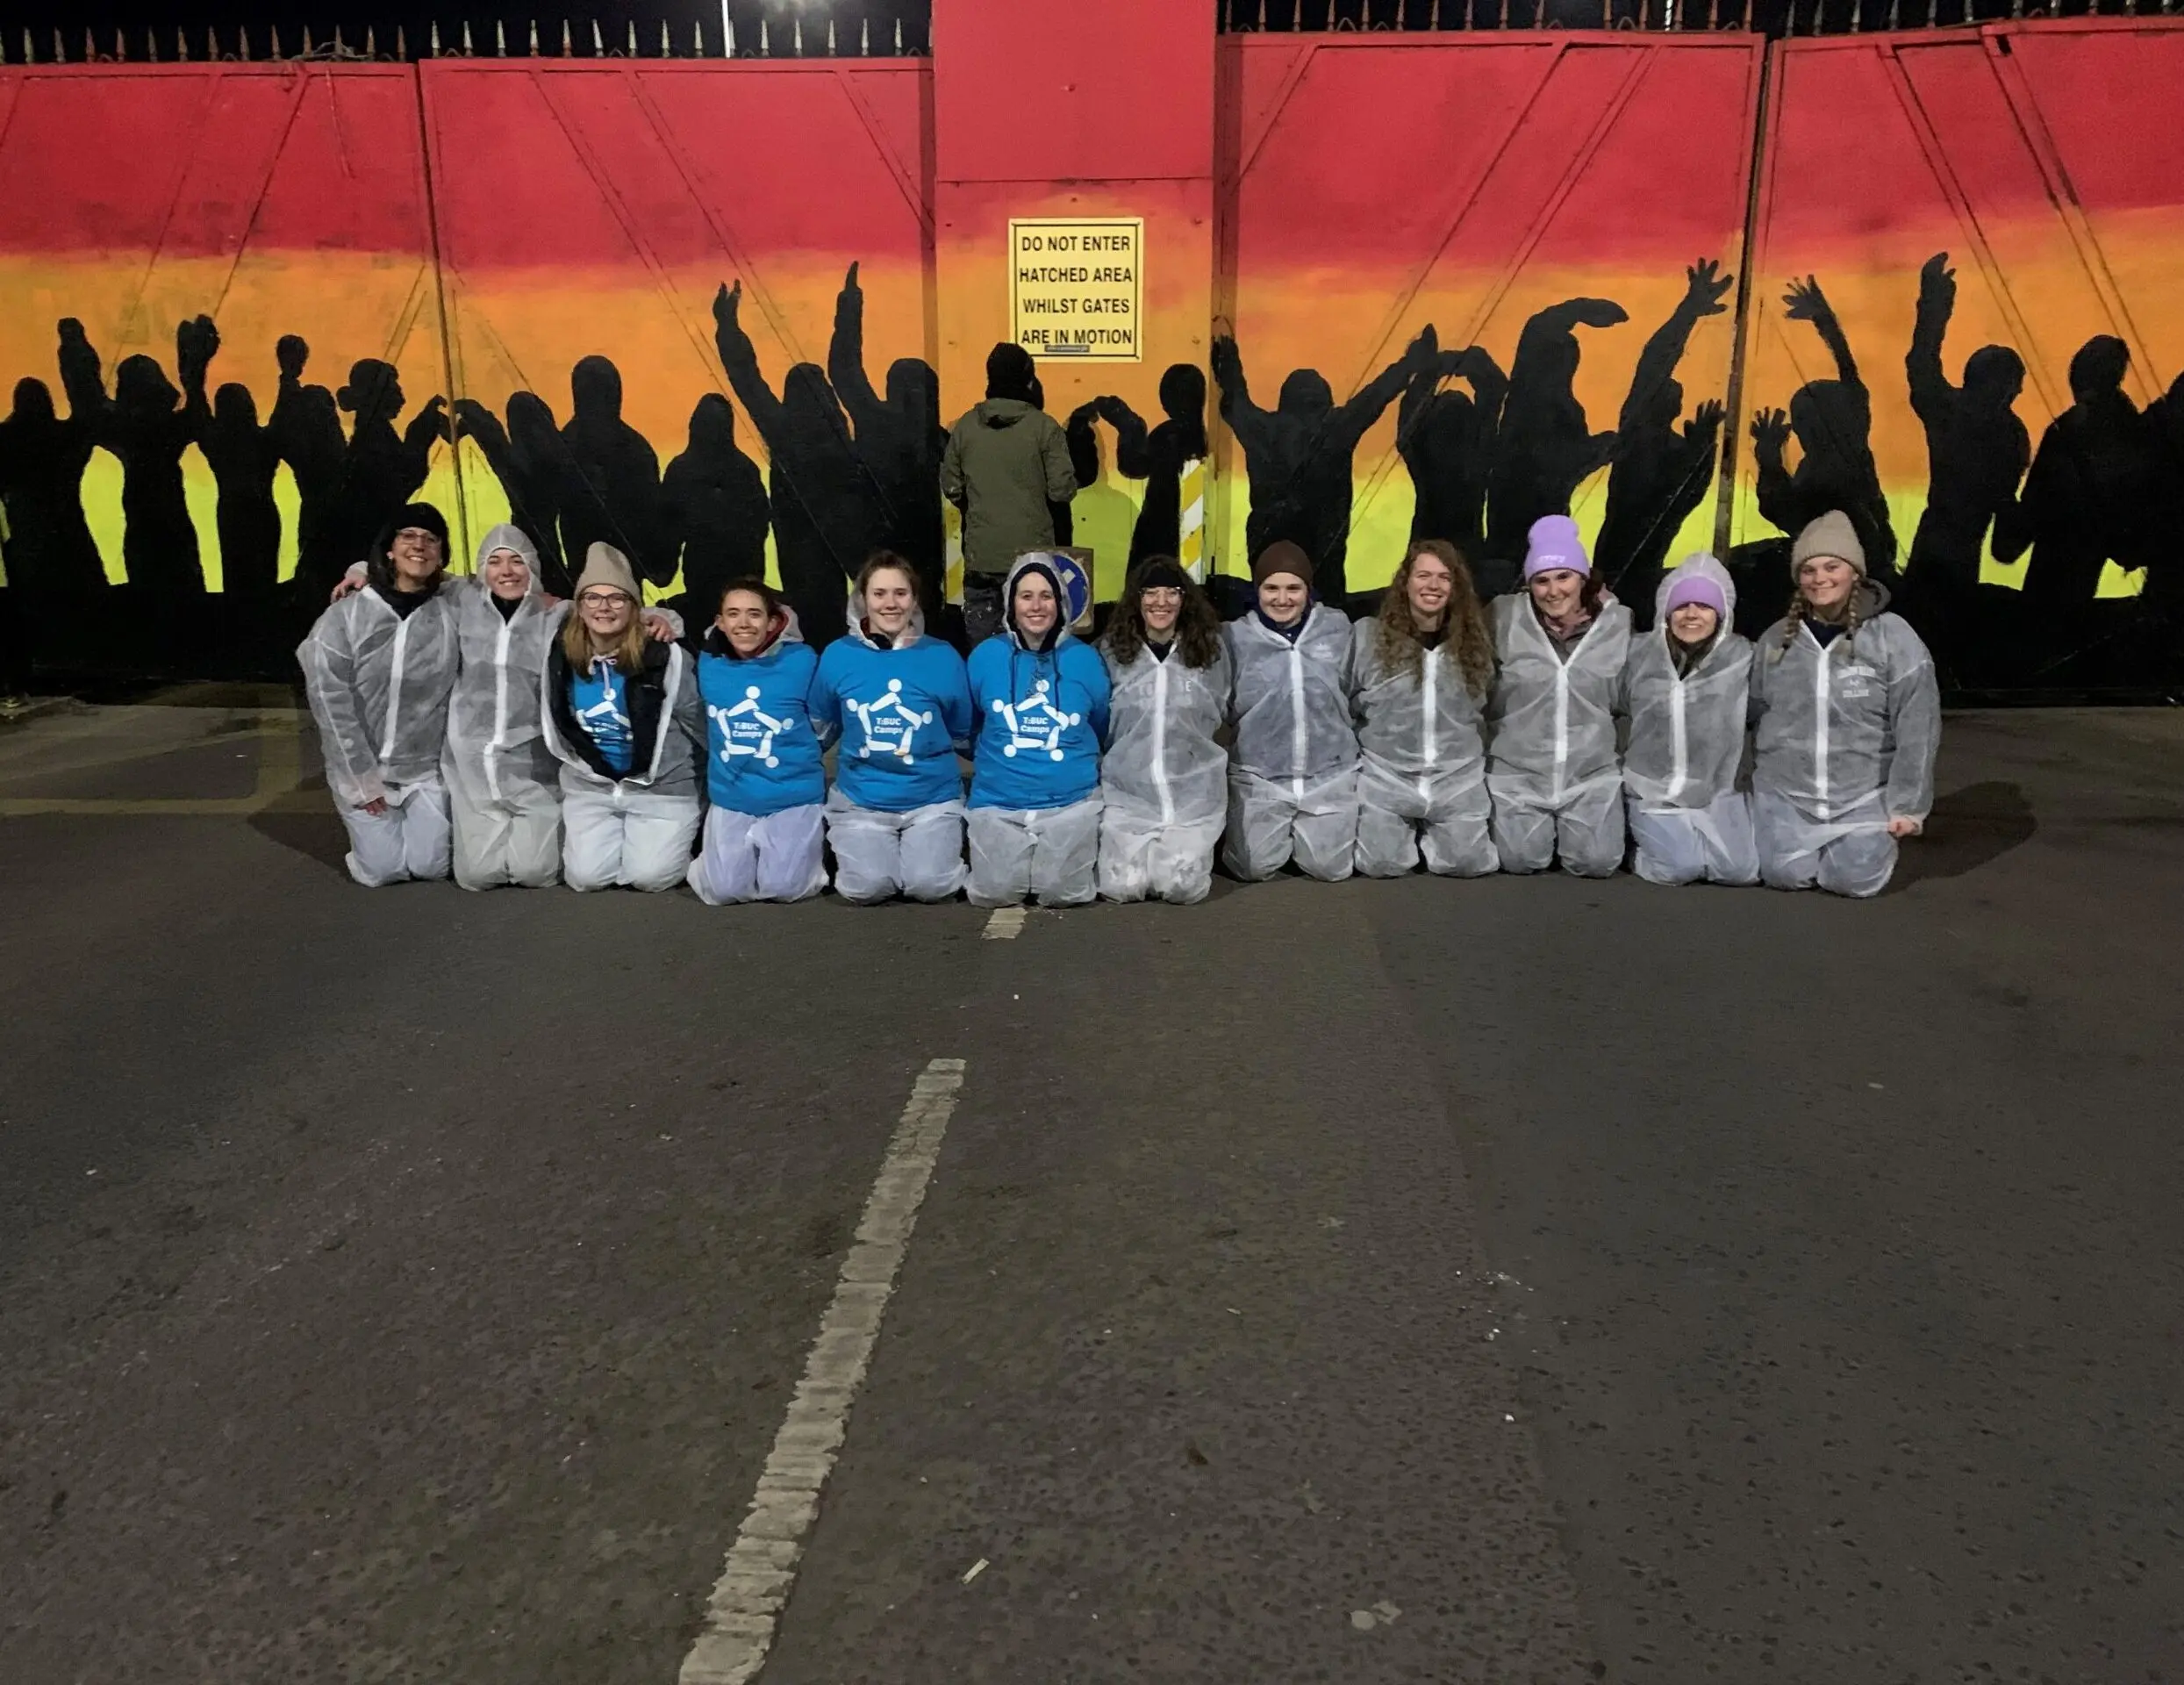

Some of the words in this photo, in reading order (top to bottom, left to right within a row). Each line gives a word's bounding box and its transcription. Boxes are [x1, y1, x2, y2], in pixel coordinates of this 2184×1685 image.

[1022, 236, 1042, 251] DO
[1049, 236, 1078, 251] NOT
[1083, 236, 1129, 251] ENTER
[1020, 268, 1088, 282] HATCHED
[1093, 268, 1132, 282] AREA
[1023, 298, 1078, 313] WHILST
[1083, 298, 1129, 313] GATES
[1021, 330, 1049, 344] ARE
[1056, 330, 1069, 343] IN
[1075, 329, 1131, 344] MOTION
[732, 730, 763, 739] Camps
[874, 726, 904, 735] Camps
[1020, 725, 1050, 735] Camps
